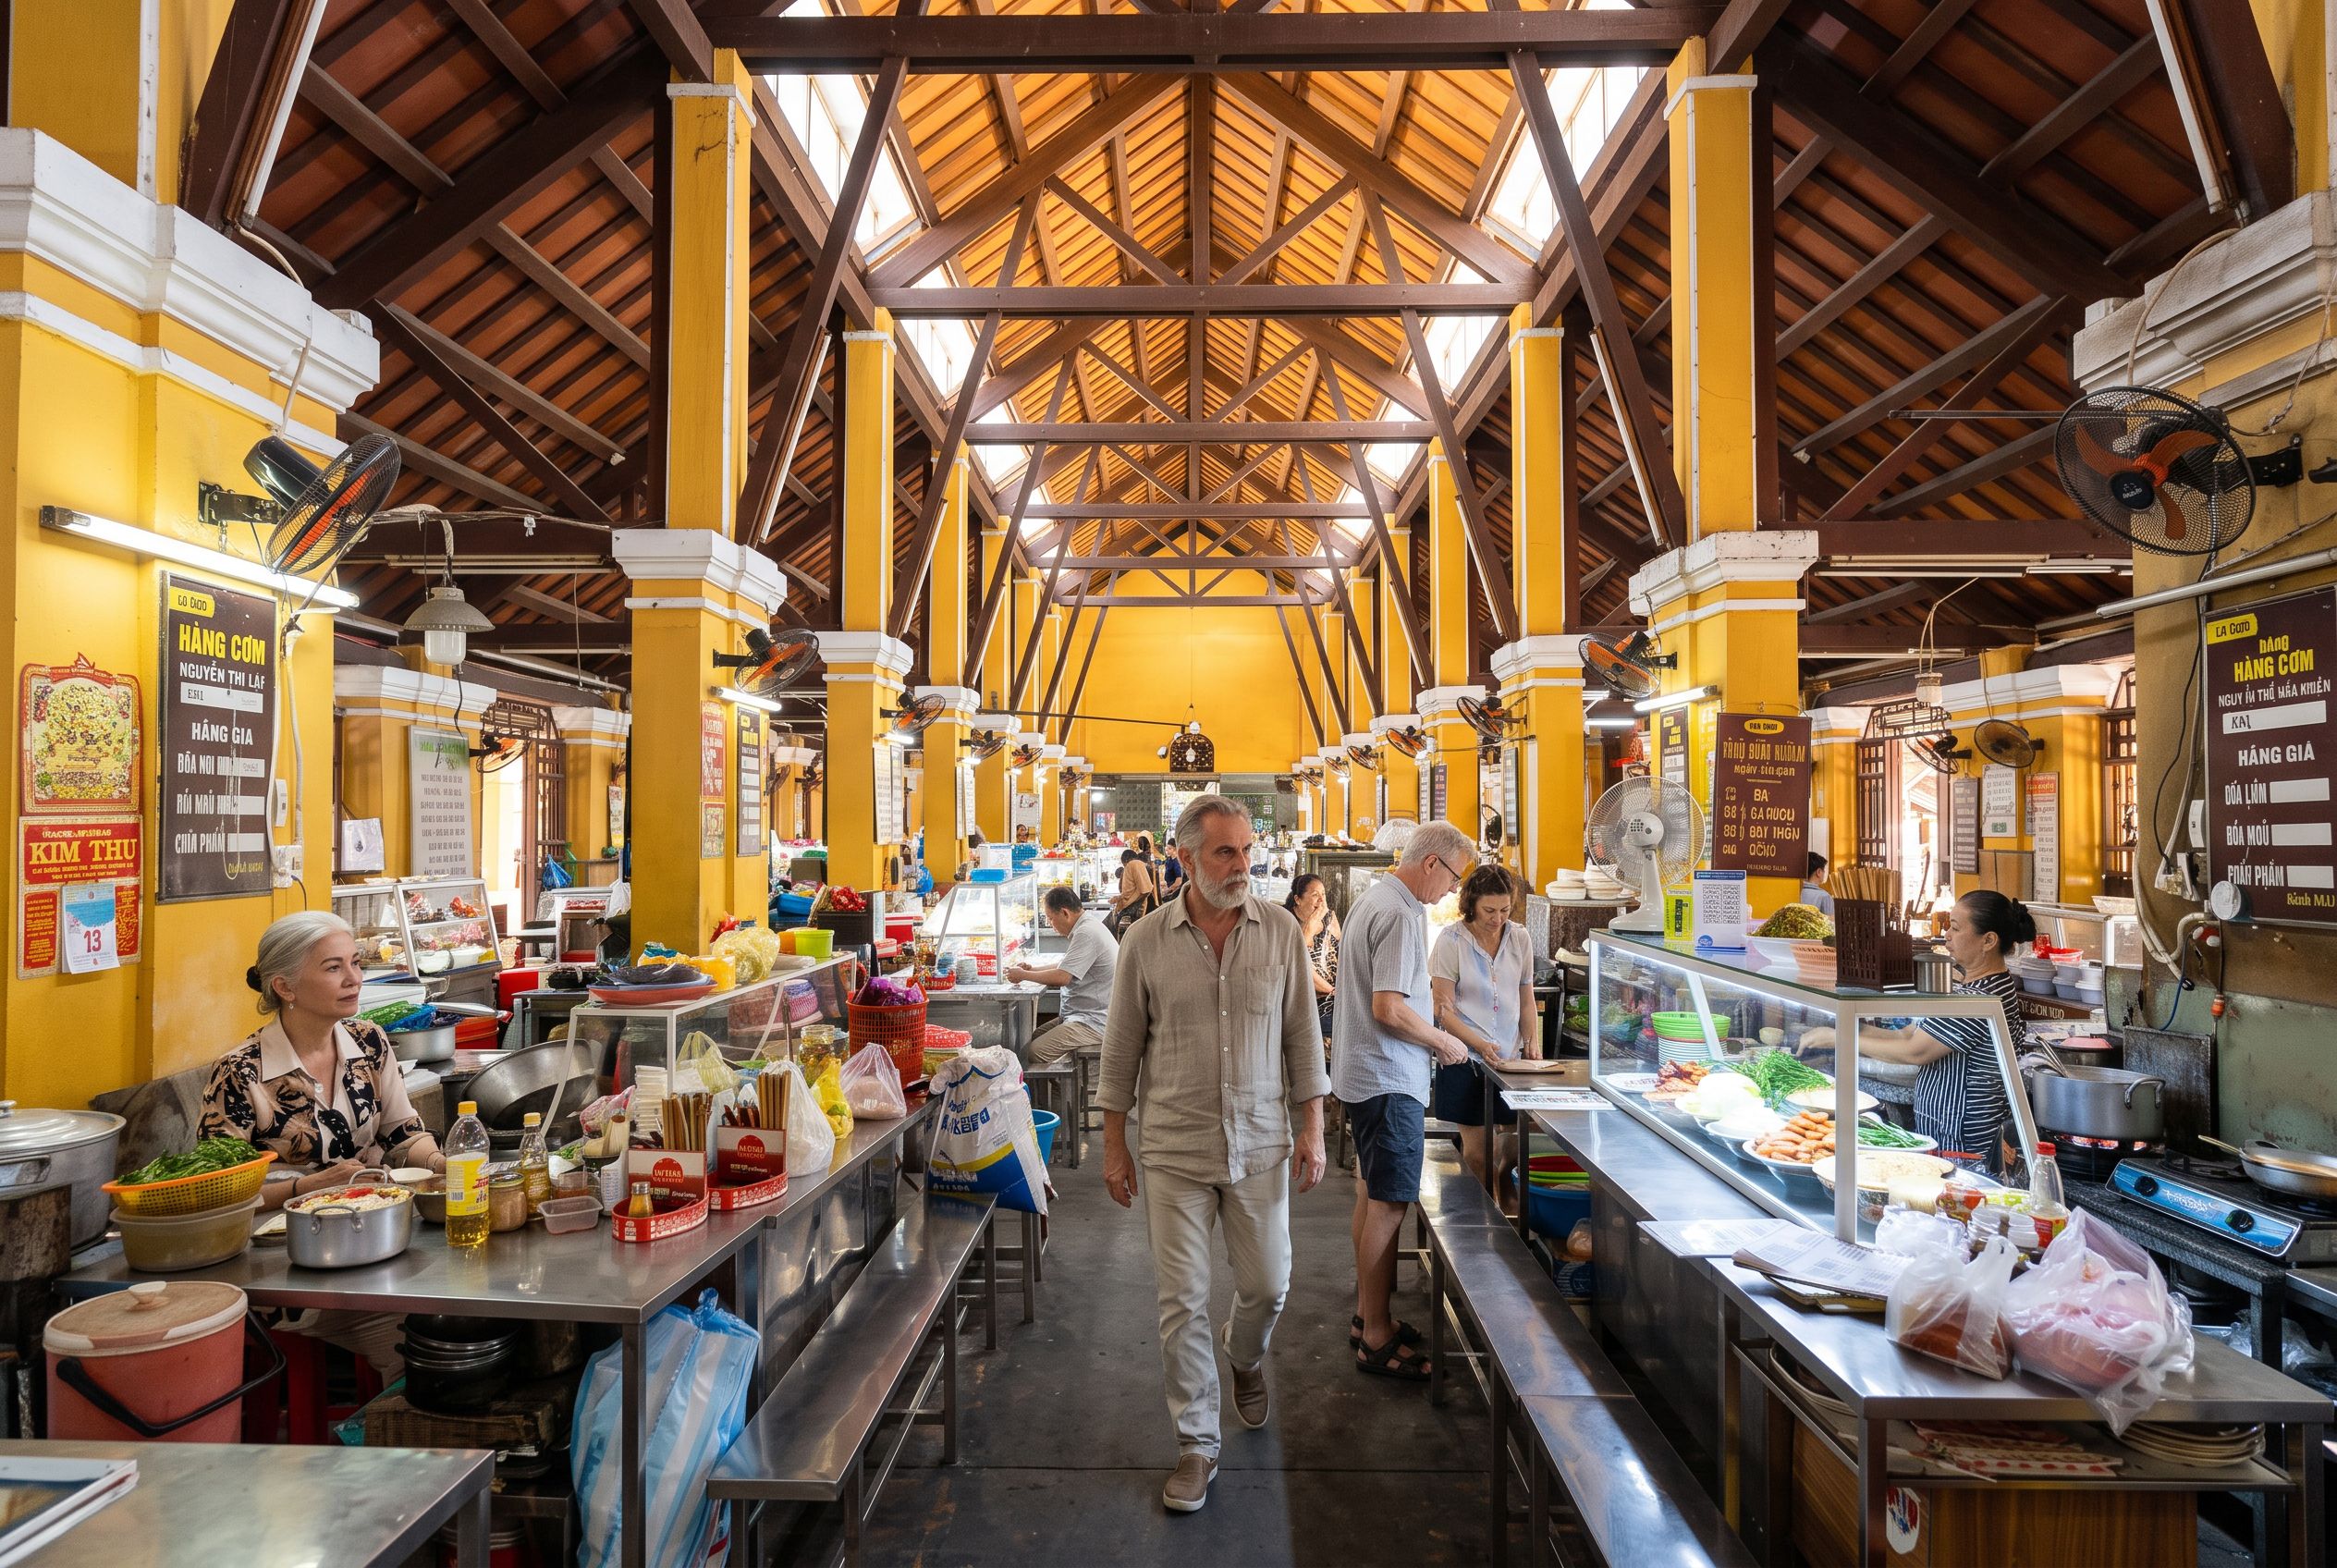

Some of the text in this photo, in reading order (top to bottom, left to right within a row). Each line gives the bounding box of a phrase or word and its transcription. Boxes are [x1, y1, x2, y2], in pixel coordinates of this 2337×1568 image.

[230, 634, 266, 666] CƠM
[2278, 648, 2315, 676] CƠM
[231, 727, 254, 746] GIA
[28, 839, 138, 865] KIM THU
[83, 929, 102, 953] 13
